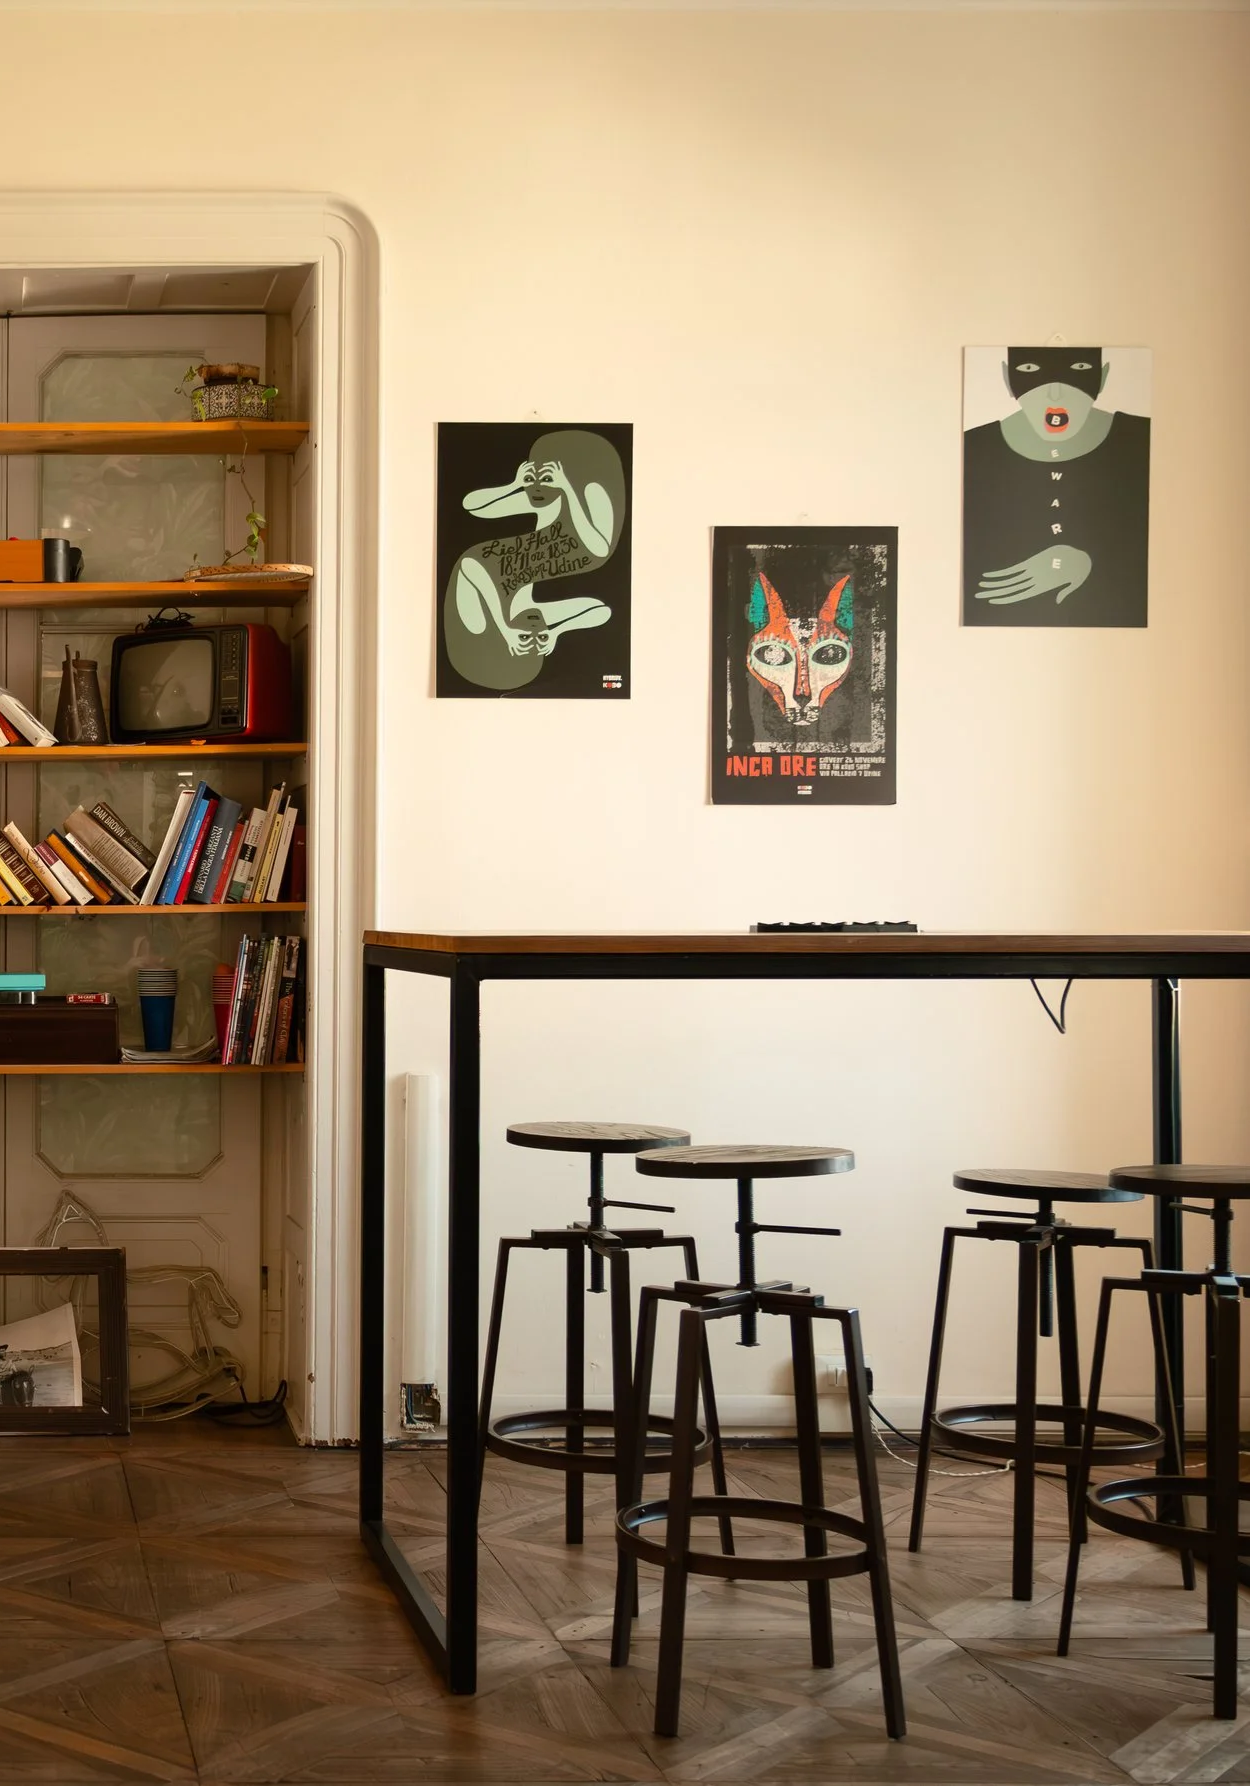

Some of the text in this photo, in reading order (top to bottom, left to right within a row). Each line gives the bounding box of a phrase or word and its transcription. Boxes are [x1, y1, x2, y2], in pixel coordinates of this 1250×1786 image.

[482, 521, 568, 559] Lief Hall
[547, 555, 591, 577] Udine
[726, 755, 817, 777] INCA ORE
[854, 756, 887, 764] NOVEMBRE
[93, 805, 127, 838] DAN BROWN
[192, 858, 208, 893] DIZIONARIO
[204, 824, 218, 856] GARZANTI
[197, 874, 208, 894] DELLA
[203, 852, 215, 875] LINGUA
[209, 825, 223, 854] ITALIANA
[285, 981, 293, 995] The
